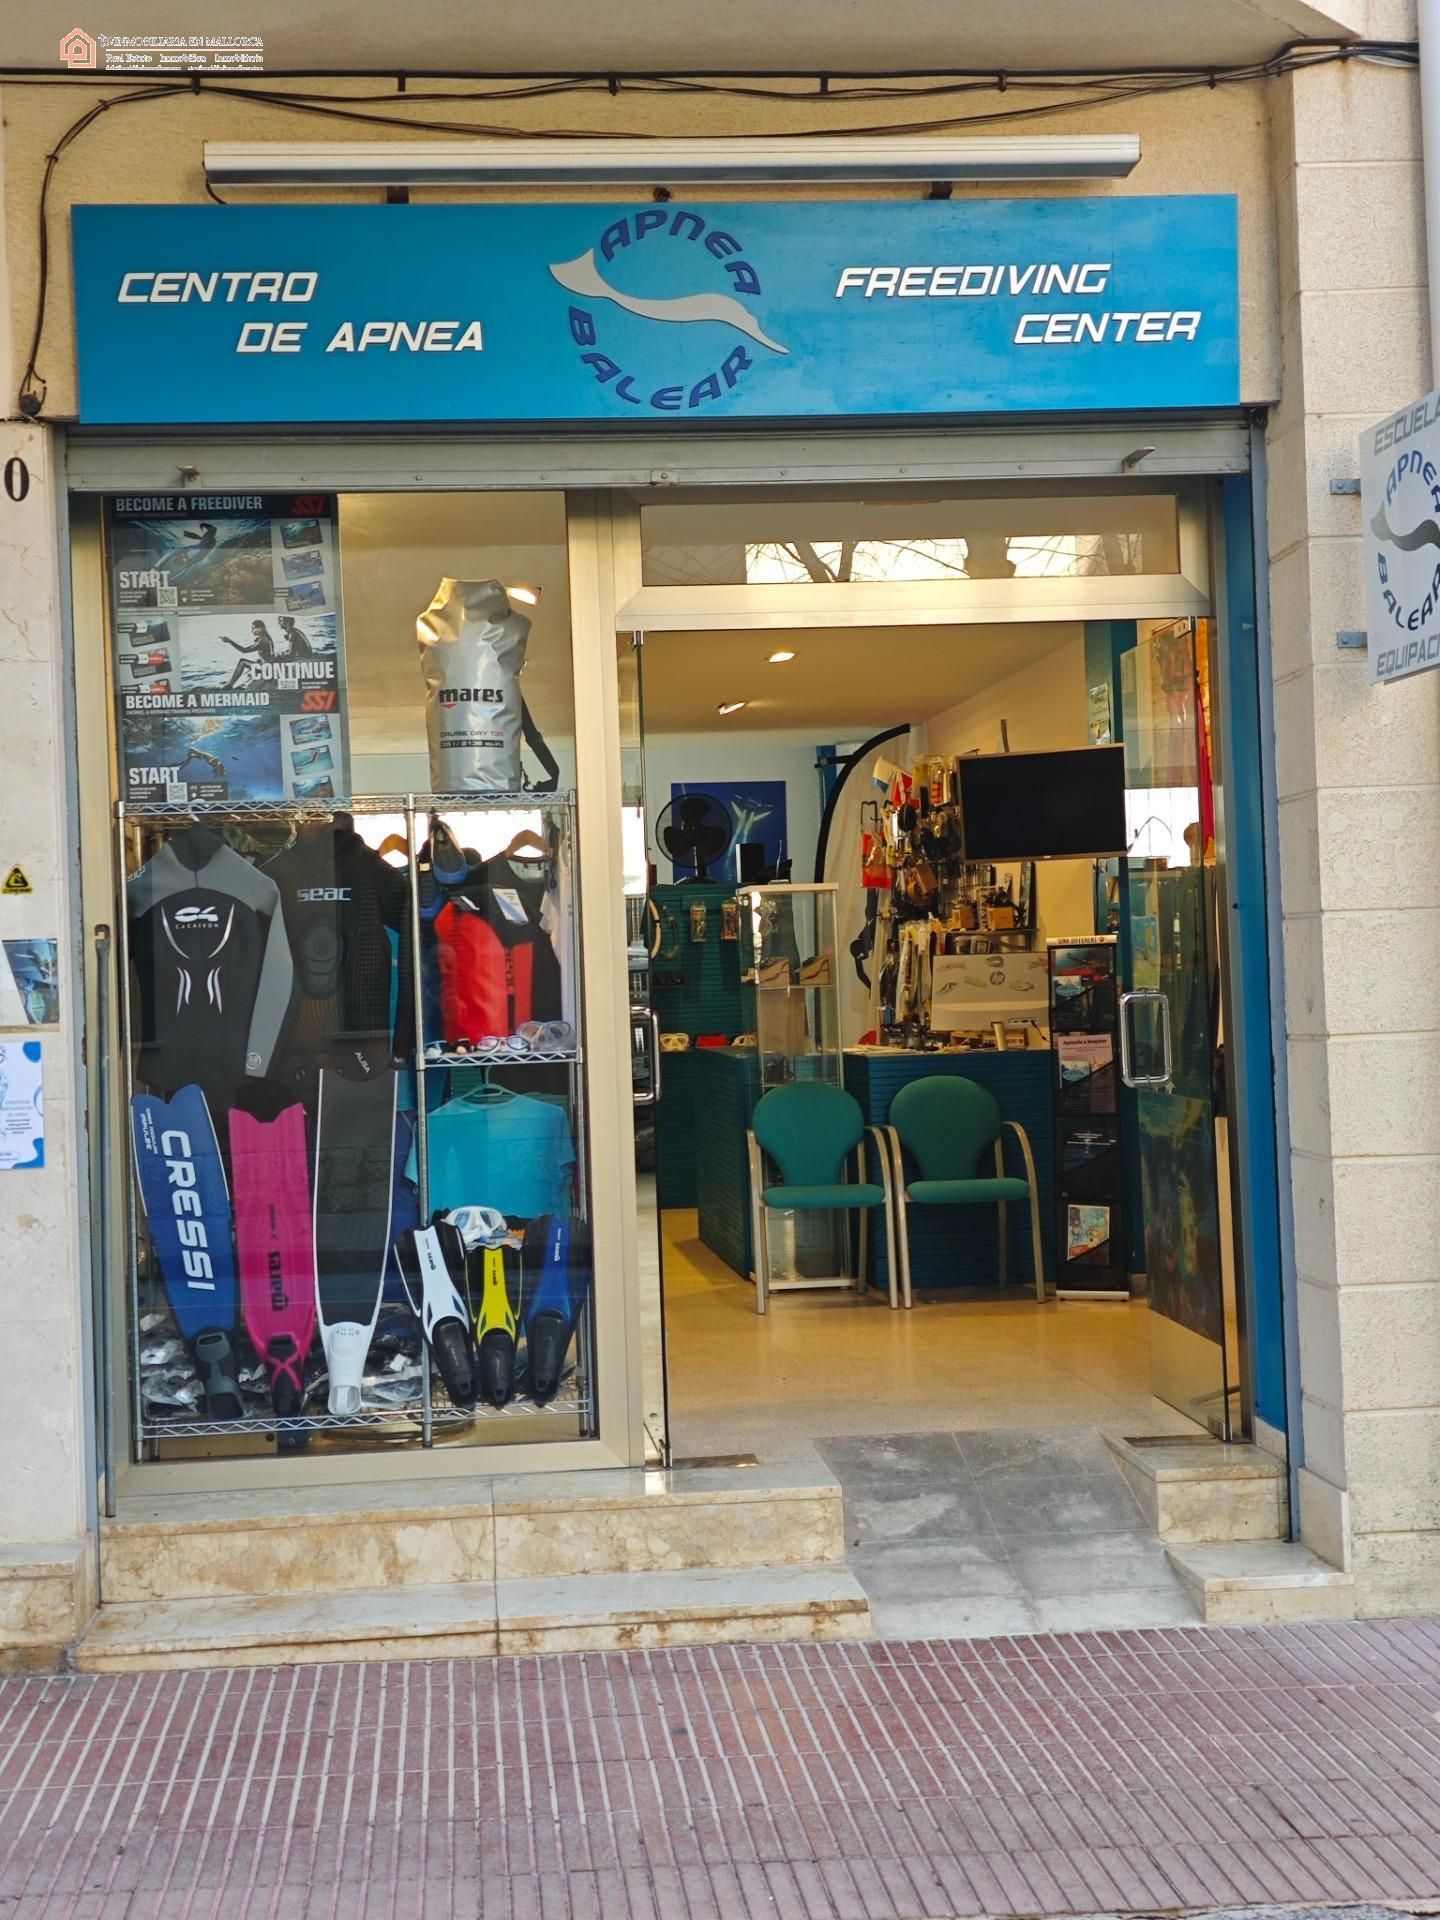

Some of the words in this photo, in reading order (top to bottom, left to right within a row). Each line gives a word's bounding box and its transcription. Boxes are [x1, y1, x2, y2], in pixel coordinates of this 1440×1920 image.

[601, 210, 760, 295] APNEA
[117, 272, 319, 304] CENTRO
[834, 263, 1112, 299] FREEDIVING
[236, 322, 308, 353] DE
[325, 321, 485, 352] APNEA
[1013, 311, 1202, 345] CENTER
[569, 305, 754, 411] BALEAR
[116, 497, 173, 512] BECOME
[178, 497, 188, 511] A
[191, 496, 263, 511] FREEDIVER
[119, 570, 171, 589] START
[251, 661, 335, 681] CONTINUE
[126, 694, 183, 709] BECOME
[187, 693, 198, 708] A
[200, 692, 270, 708] MERMAID
[302, 690, 337, 712] SSI
[439, 688, 504, 703] mares
[129, 766, 181, 785] START
[297, 887, 352, 902] seac
[160, 1129, 216, 1291] CRESSI
